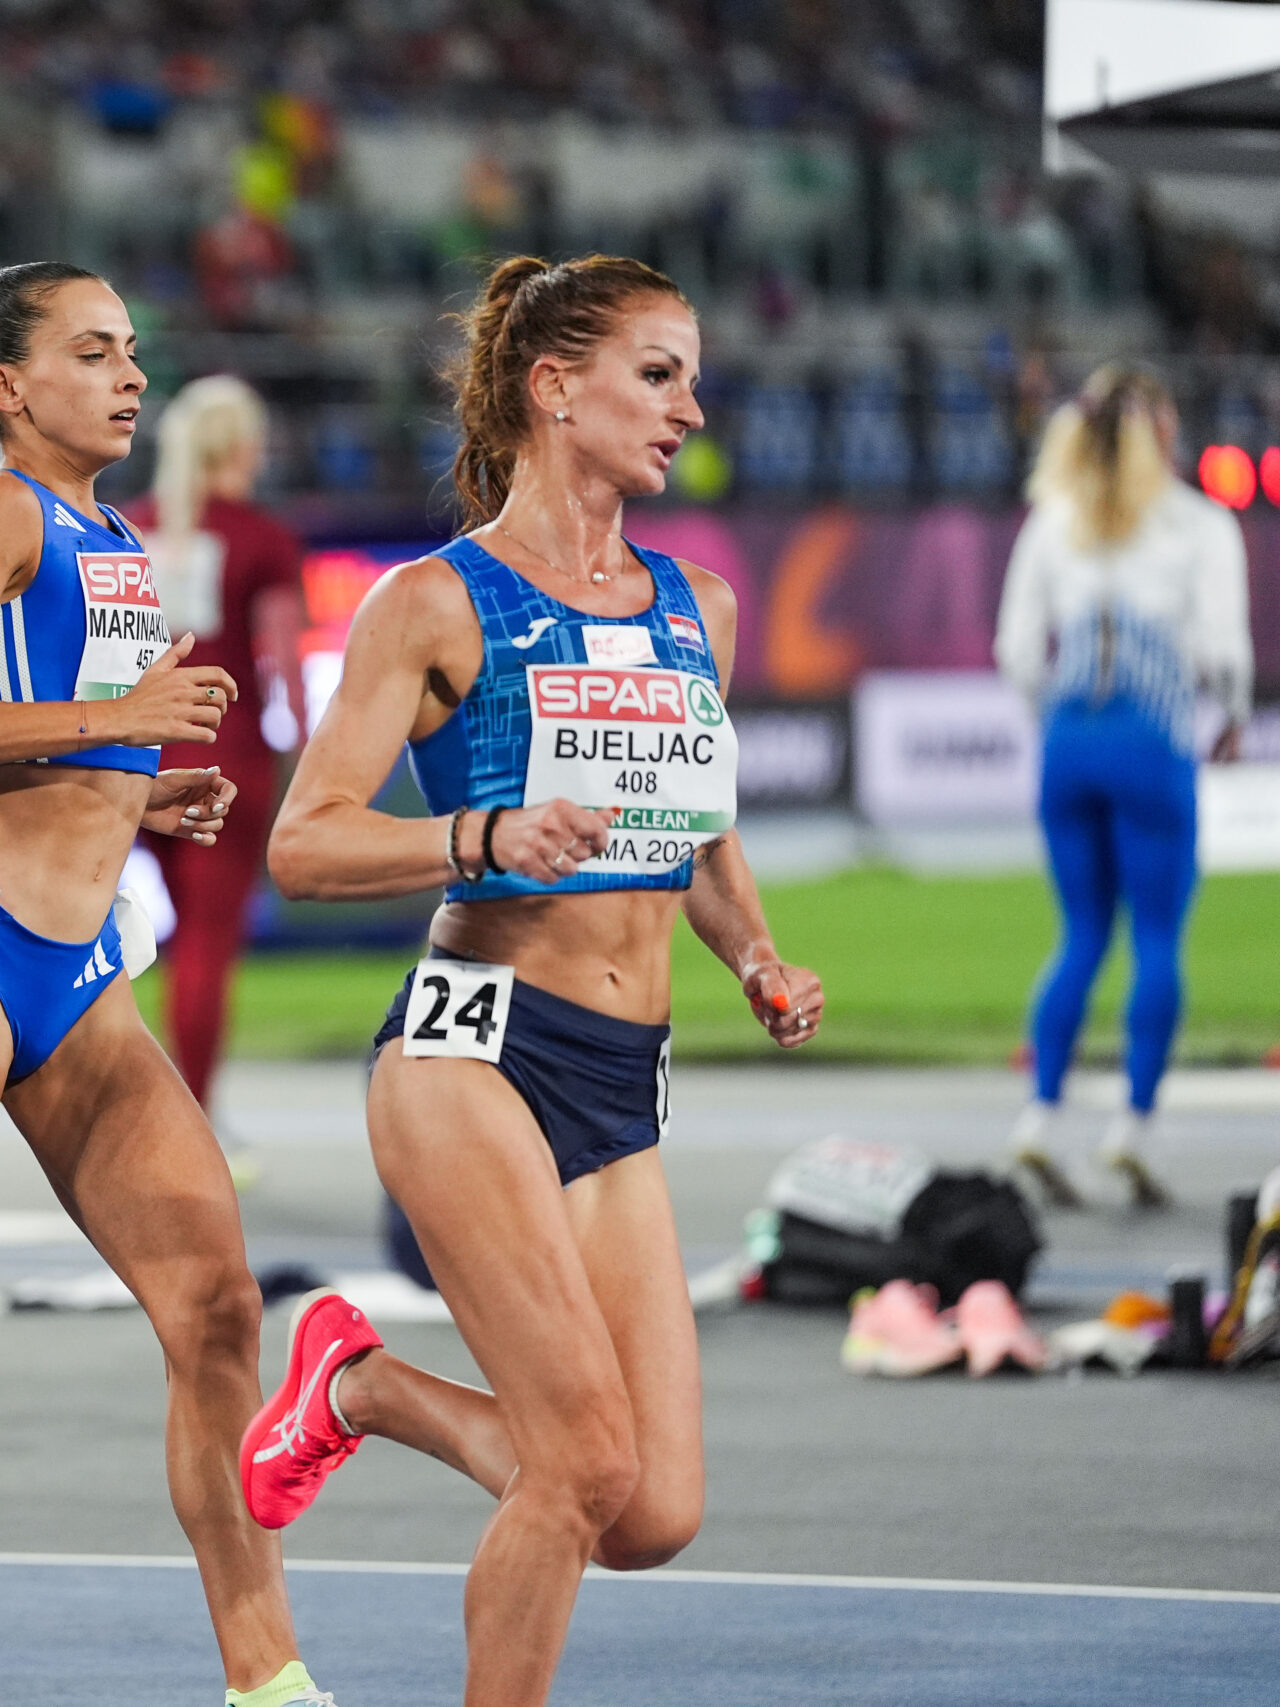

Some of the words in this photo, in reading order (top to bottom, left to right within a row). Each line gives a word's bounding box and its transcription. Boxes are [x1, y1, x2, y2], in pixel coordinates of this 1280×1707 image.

[86, 562, 156, 599] SPA
[136, 648, 154, 671] 457
[538, 675, 683, 718] SPAR
[554, 728, 715, 765] BJELJAC
[614, 770, 658, 794] 408
[599, 838, 638, 862] MA
[646, 839, 694, 863] 202
[412, 975, 498, 1046] 24
